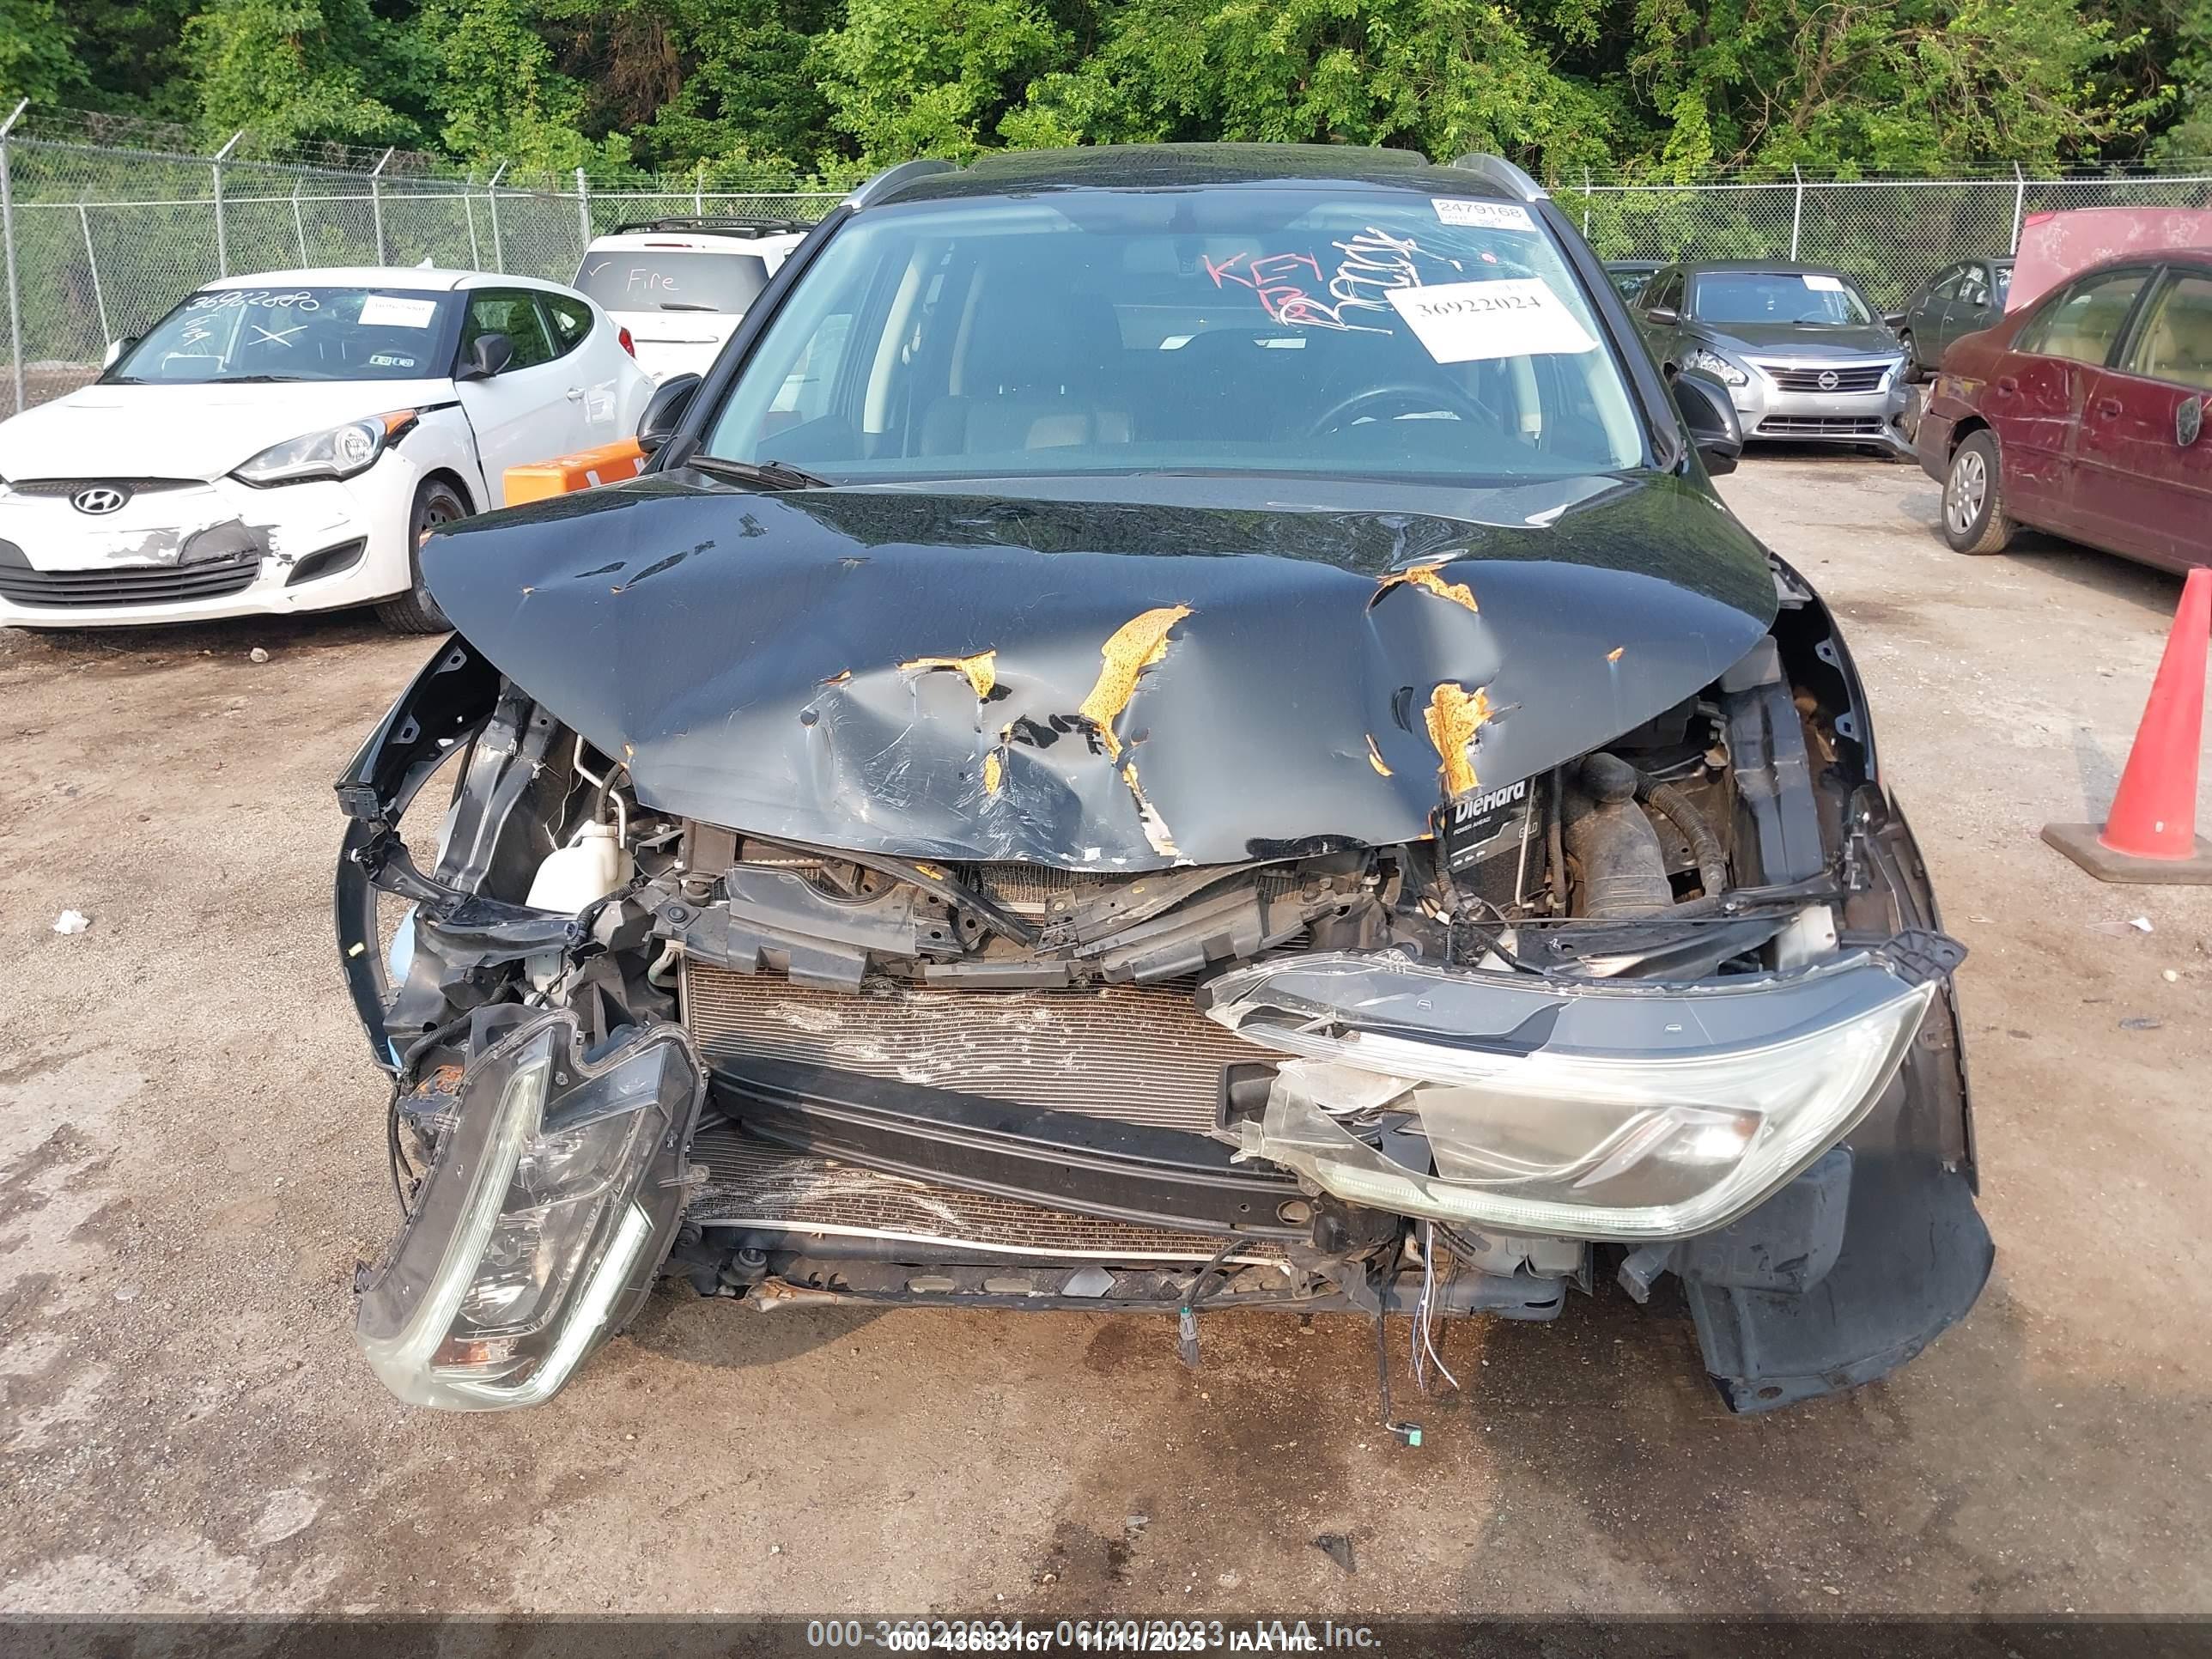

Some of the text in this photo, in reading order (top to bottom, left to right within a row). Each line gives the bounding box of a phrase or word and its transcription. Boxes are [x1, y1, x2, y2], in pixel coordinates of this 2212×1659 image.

[1438, 202, 1522, 218] 2479168
[626, 268, 681, 293] Fire
[1201, 252, 1323, 289] KEY
[1416, 295, 1541, 318] 36922024
[1518, 822, 1539, 839] GLD
